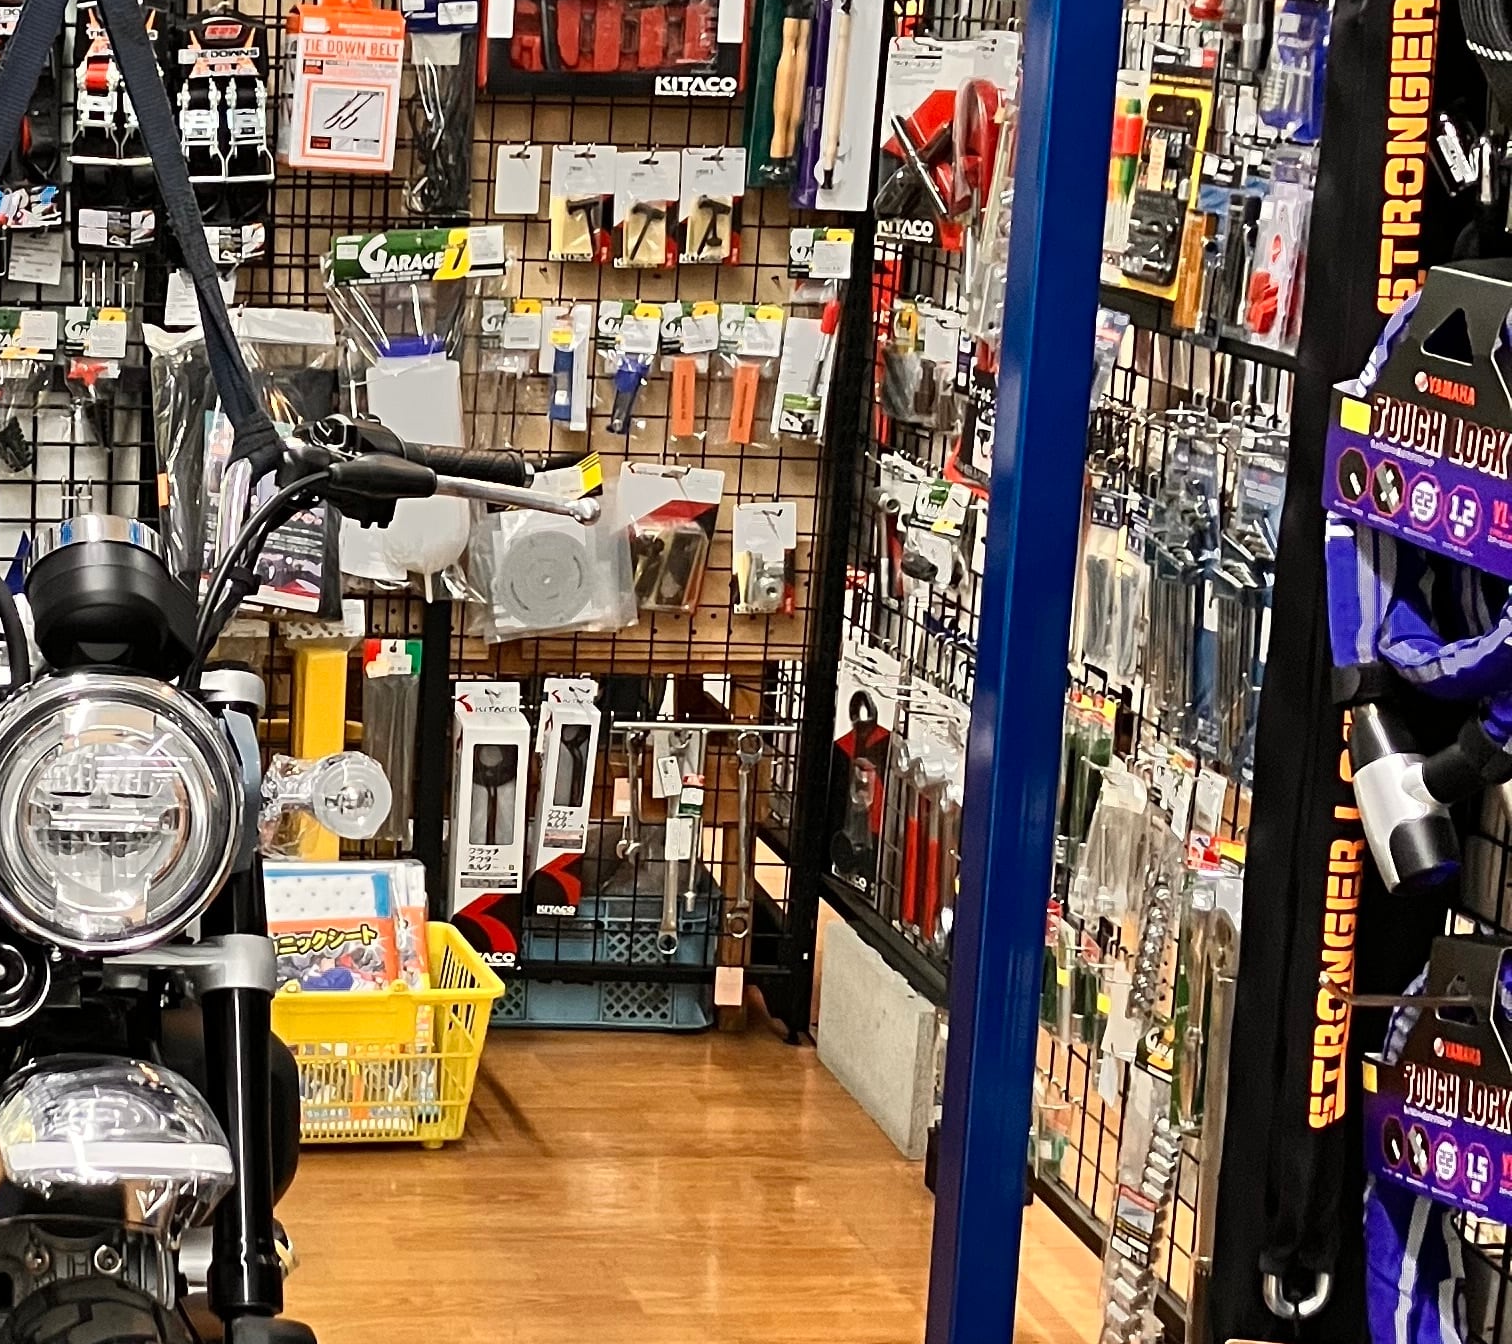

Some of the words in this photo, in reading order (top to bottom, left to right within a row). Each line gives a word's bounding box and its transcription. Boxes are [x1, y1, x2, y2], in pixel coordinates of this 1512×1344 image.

[210, 47, 259, 59] DOWNS
[303, 38, 322, 52] TIE
[326, 39, 366, 56] DOWN
[370, 42, 400, 58] BELT
[654, 76, 738, 92] KITACO
[358, 233, 445, 274] GARAGE
[1429, 374, 1476, 406] YAMAHA
[1373, 394, 1447, 459] TOUGH
[1448, 418, 1512, 480] LOCK
[536, 904, 576, 914] KITACO
[274, 923, 378, 956] ニックシート
[1308, 839, 1364, 1130] STRONGER
[1403, 1063, 1461, 1119] TOUGH
[1463, 1079, 1512, 1135] LOCK
